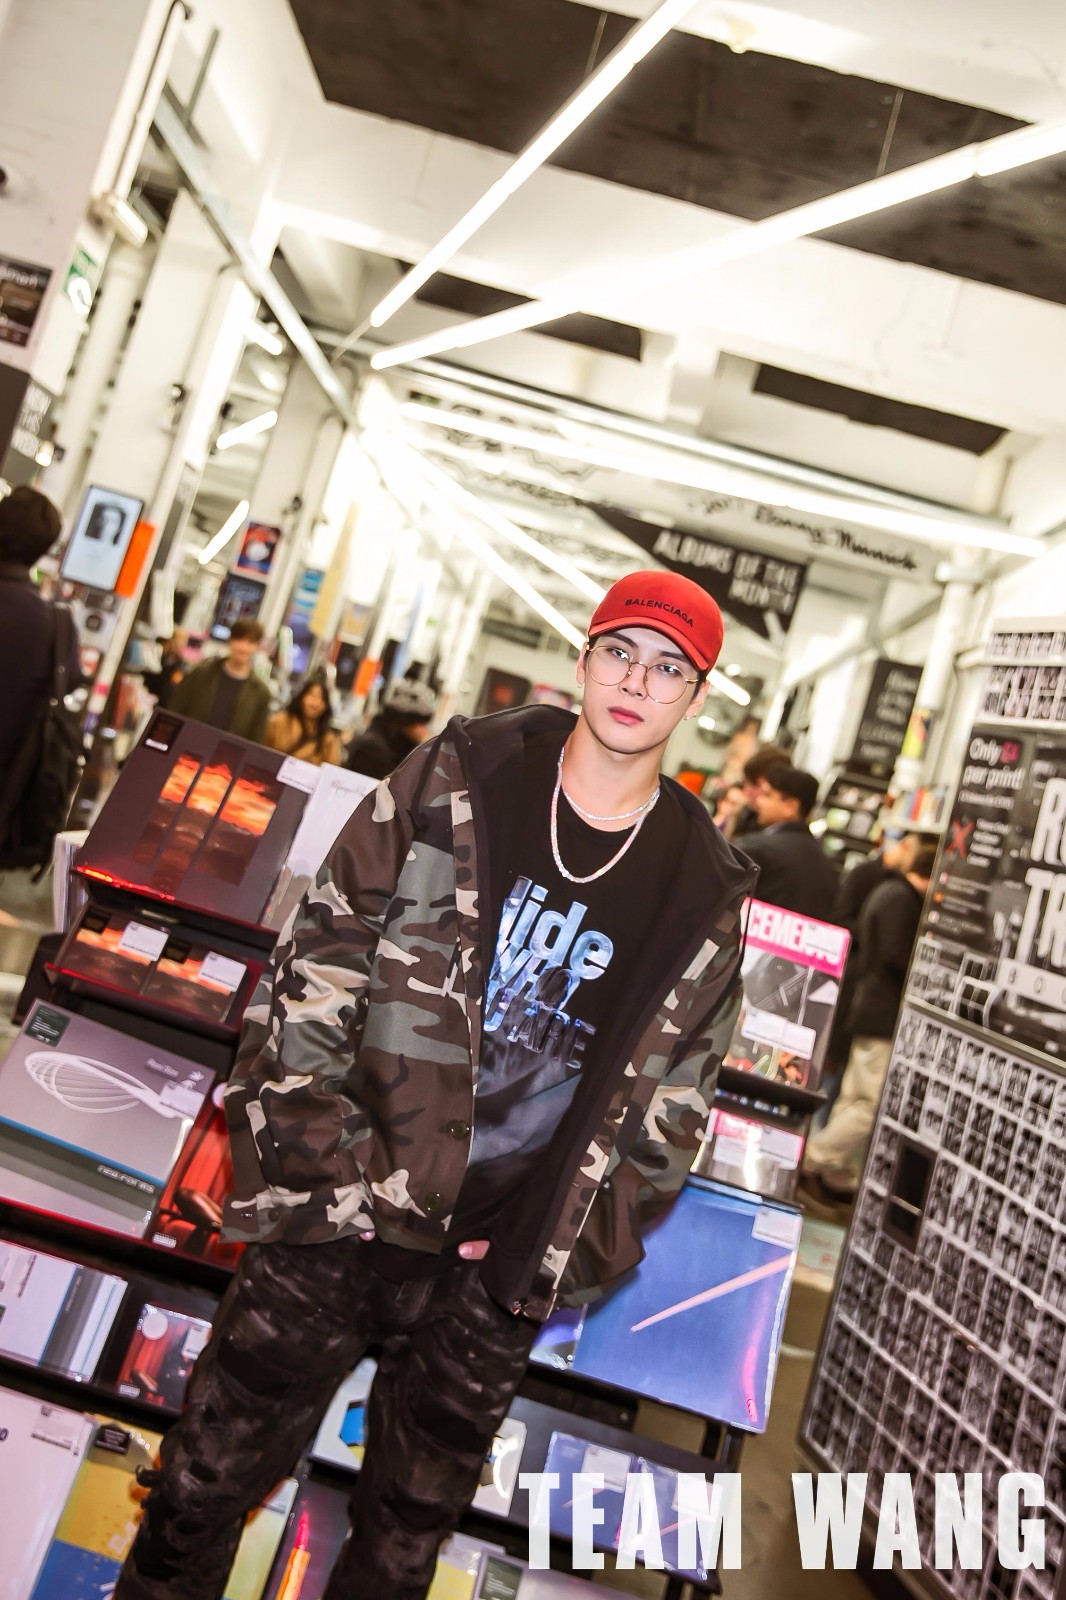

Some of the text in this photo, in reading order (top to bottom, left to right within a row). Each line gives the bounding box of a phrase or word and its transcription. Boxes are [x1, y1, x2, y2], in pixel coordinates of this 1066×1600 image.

[652, 530, 736, 574] ALBUMS
[734, 552, 761, 580] OF
[624, 598, 694, 628] BALENCIAGA
[969, 737, 1001, 766] Only
